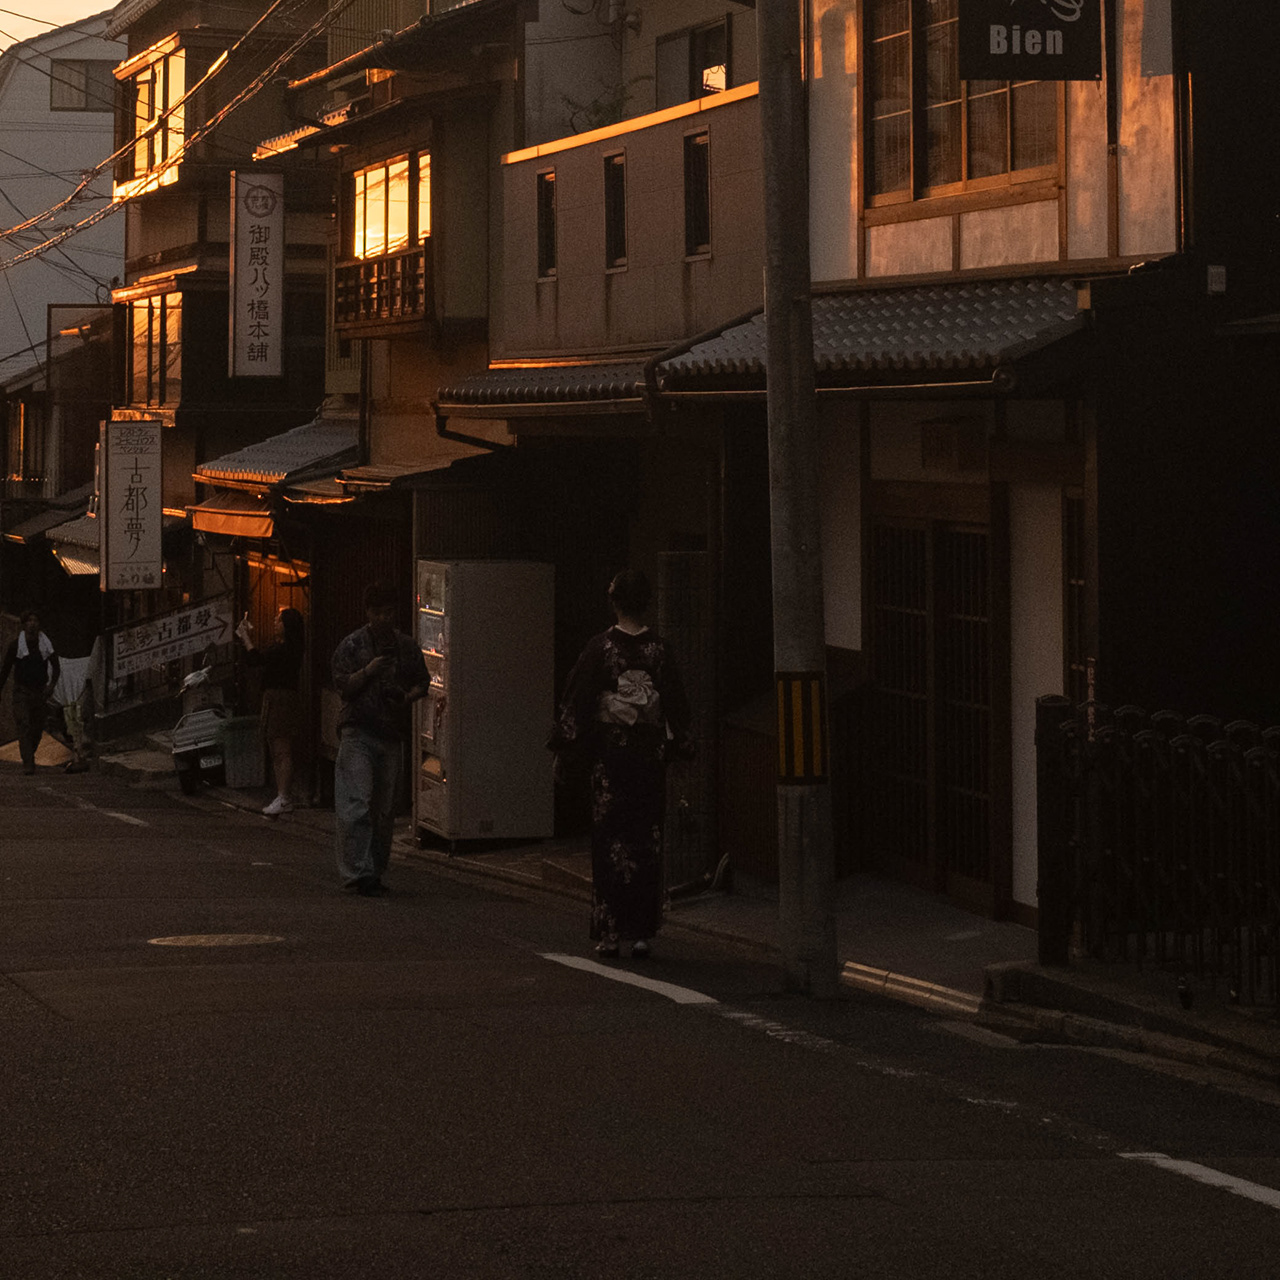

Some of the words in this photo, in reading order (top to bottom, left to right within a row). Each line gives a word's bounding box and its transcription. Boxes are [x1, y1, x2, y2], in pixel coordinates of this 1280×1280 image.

[989, 24, 1064, 55] Bien
[120, 456, 150, 560] 古都夢
